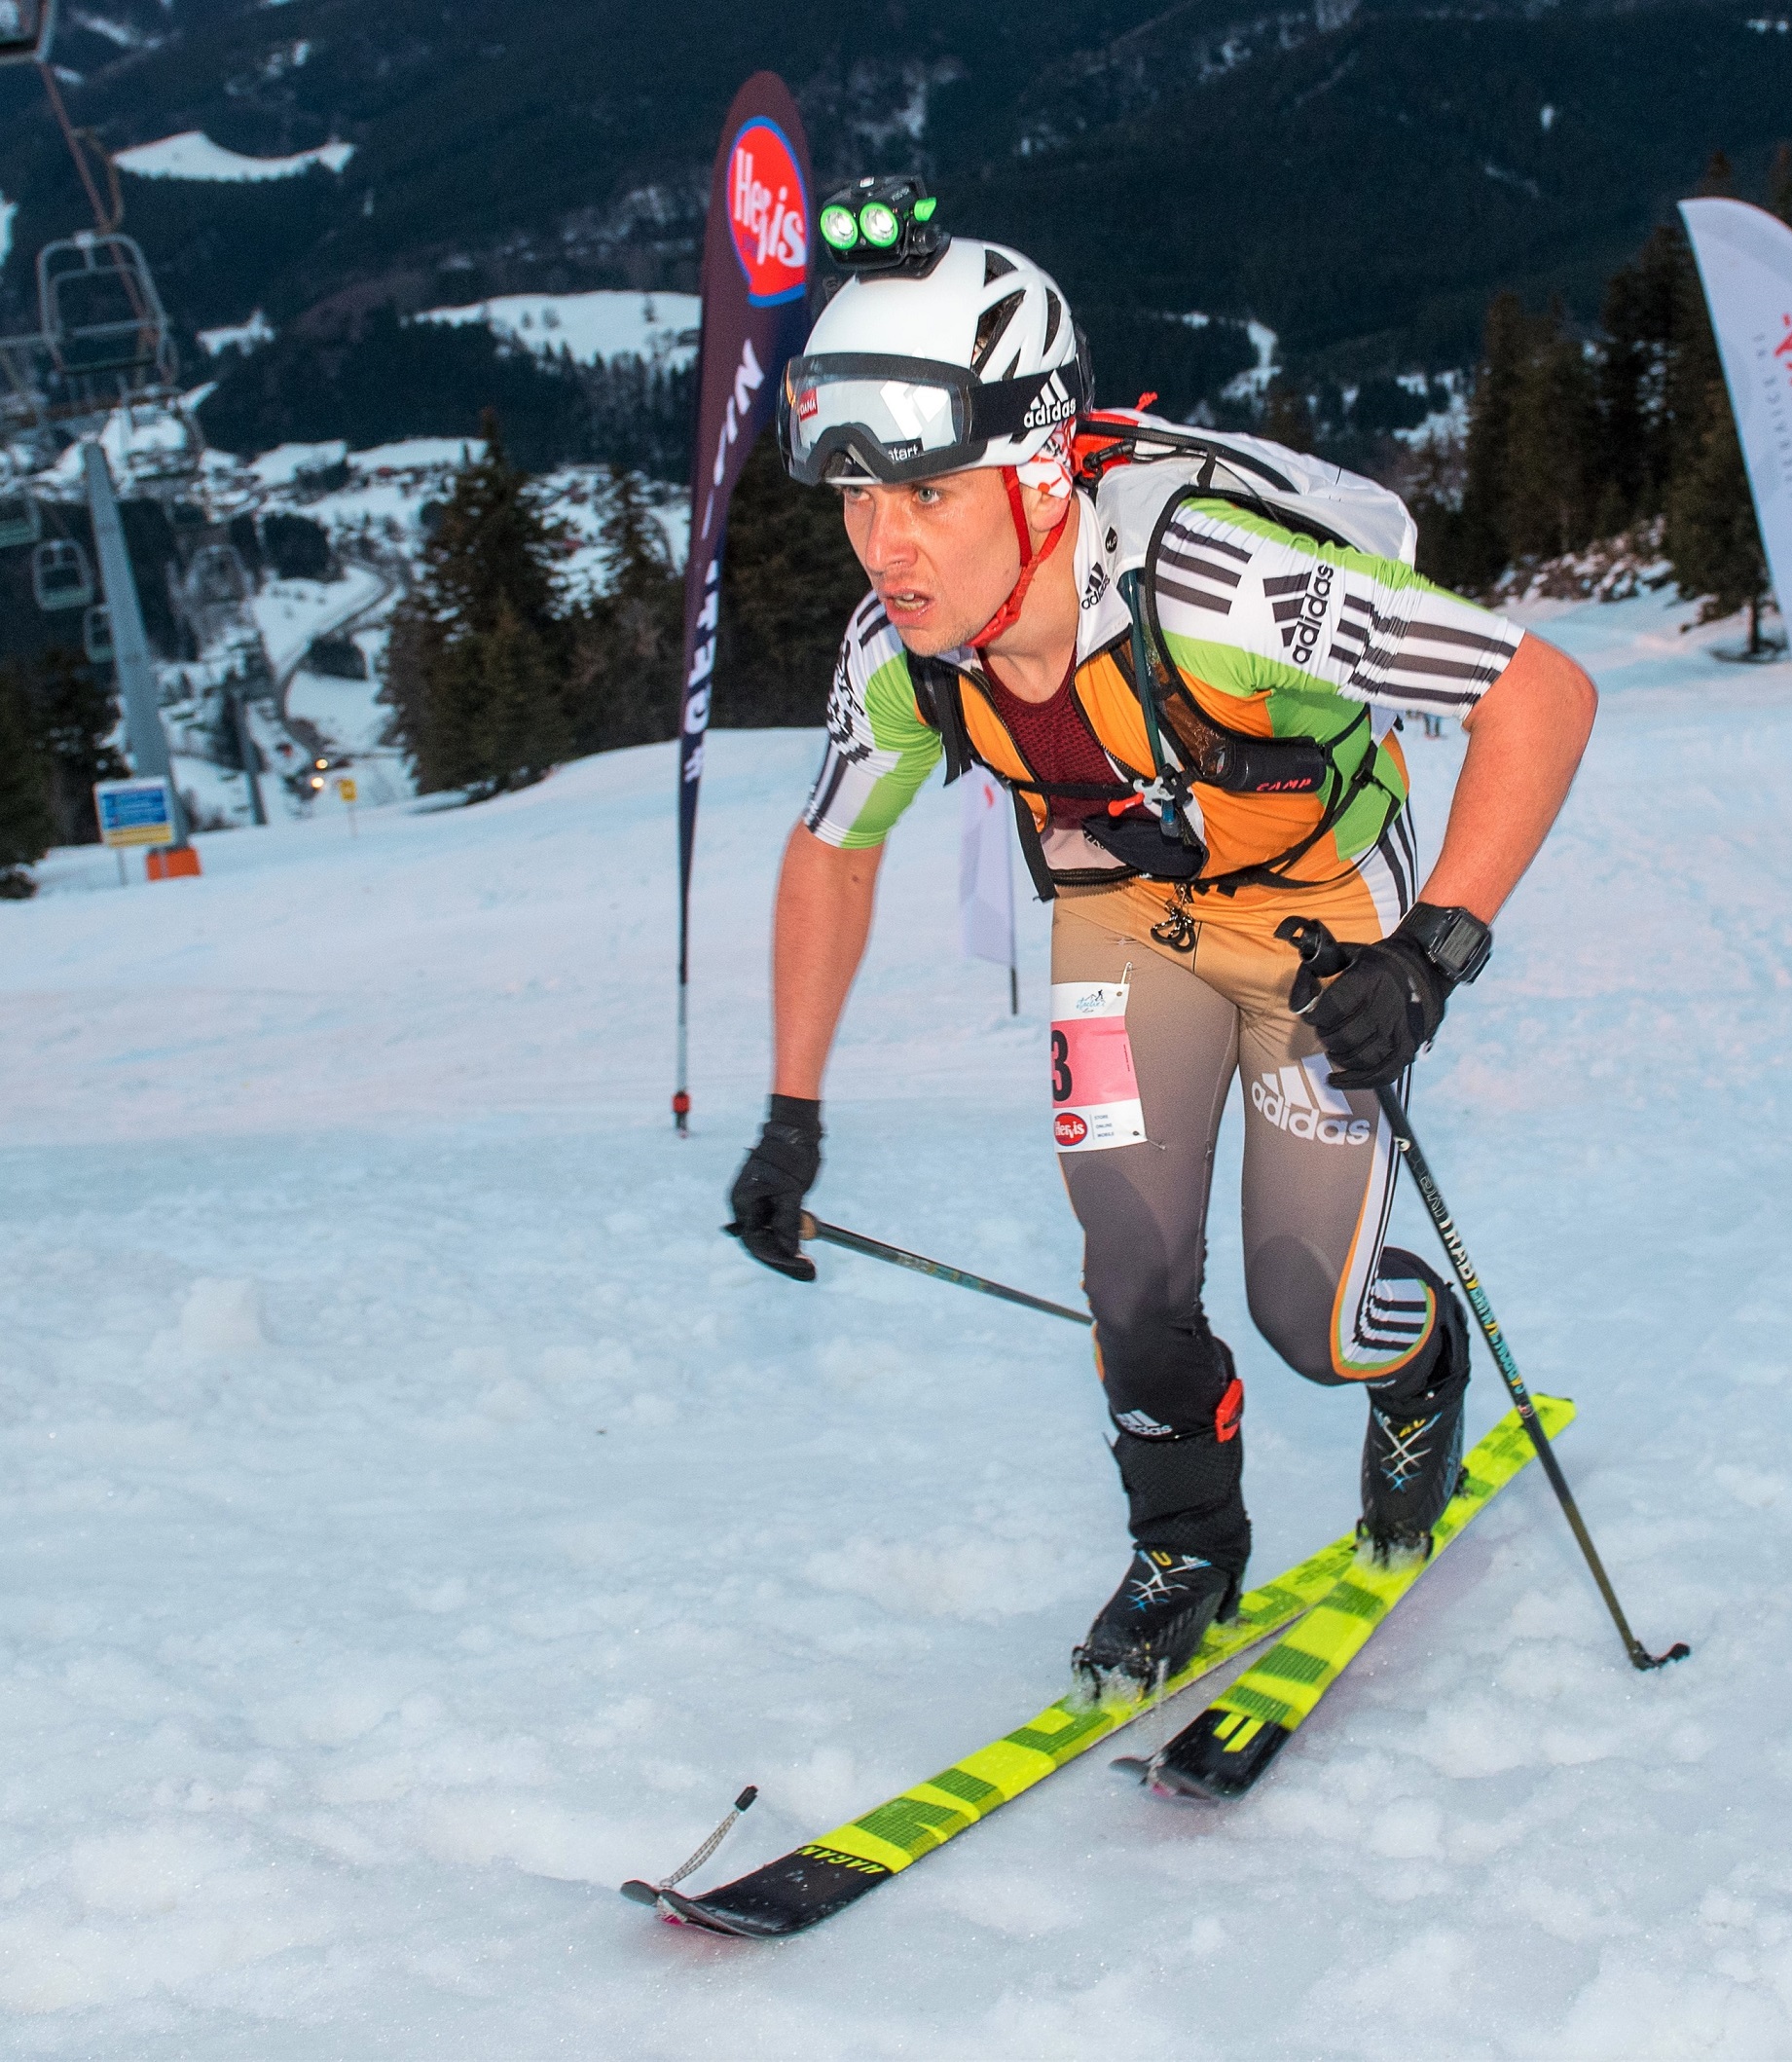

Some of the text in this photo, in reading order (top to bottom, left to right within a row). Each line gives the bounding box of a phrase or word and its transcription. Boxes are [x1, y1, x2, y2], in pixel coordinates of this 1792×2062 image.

[1023, 397, 1077, 428] adidas
[1292, 564, 1335, 665] adidas
[1256, 778, 1312, 792] CAMP
[1251, 1081, 1371, 1145] adidas
[794, 1845, 886, 1874] HAGAN
